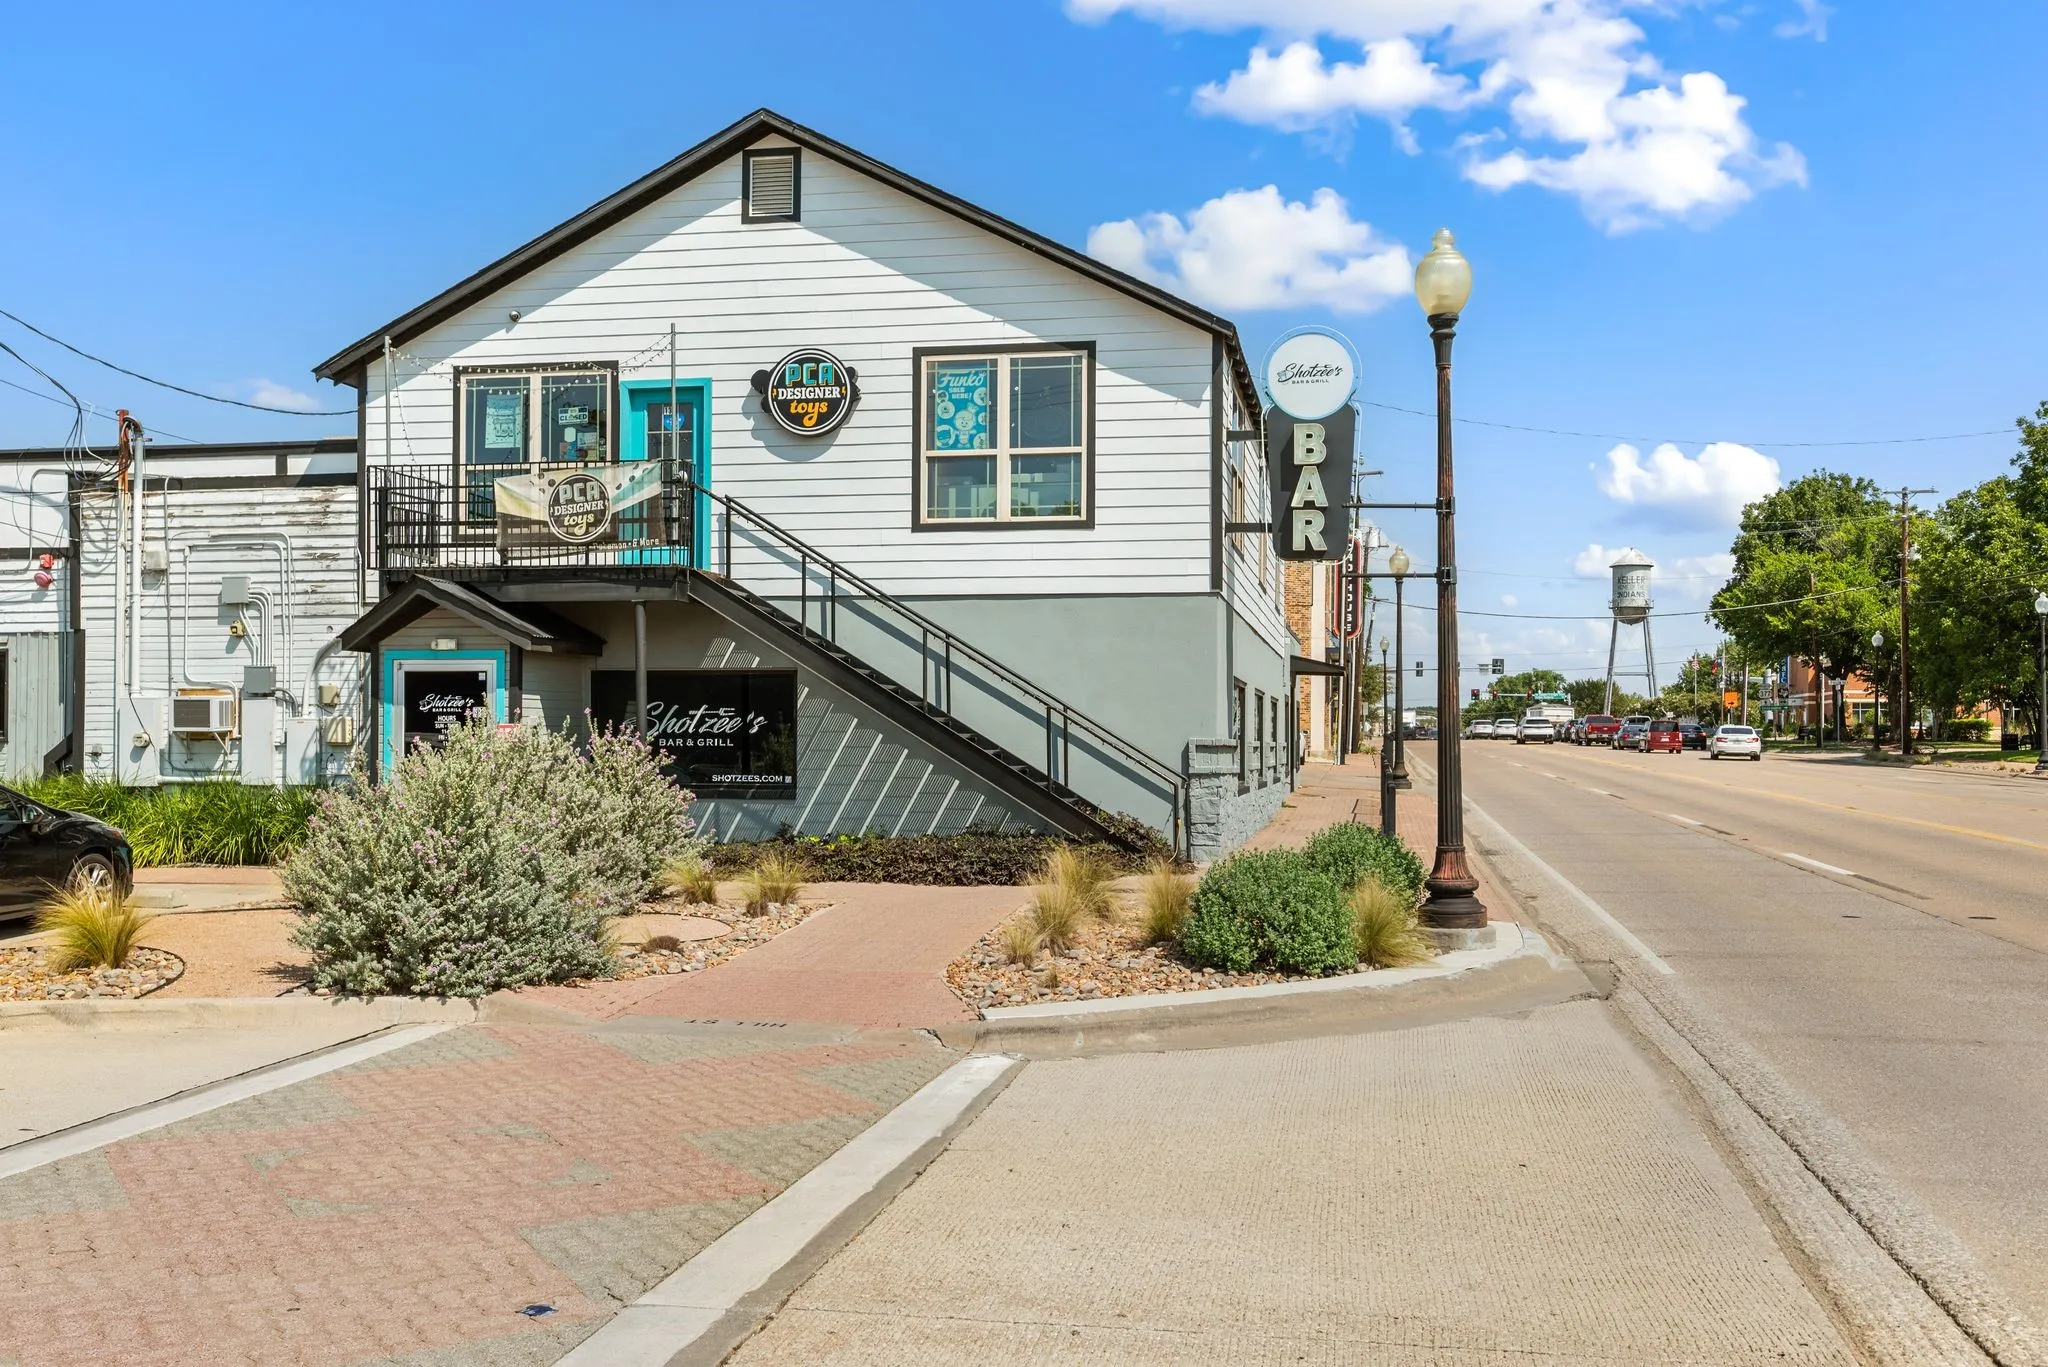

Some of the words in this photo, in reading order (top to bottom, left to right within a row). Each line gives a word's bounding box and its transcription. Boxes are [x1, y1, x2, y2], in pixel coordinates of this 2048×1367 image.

[786, 362, 835, 386] PCA
[936, 370, 985, 387] Funko
[1278, 362, 1343, 382] Shotzee's
[778, 386, 841, 400] DESIGNER
[790, 400, 828, 427] toys
[559, 481, 600, 504] PCA
[1290, 423, 1328, 551] BAR
[554, 500, 605, 516] DESIGNER
[563, 511, 595, 536] toys
[639, 537, 660, 547] More
[1617, 576, 1645, 584] KELLER
[420, 694, 475, 710] Shotzee's
[644, 701, 768, 737] Shotzee's
[658, 738, 684, 747] BAR
[686, 738, 694, 747] &
[697, 738, 734, 747] GRILL
[711, 774, 783, 783] SHOTZEES.COM
